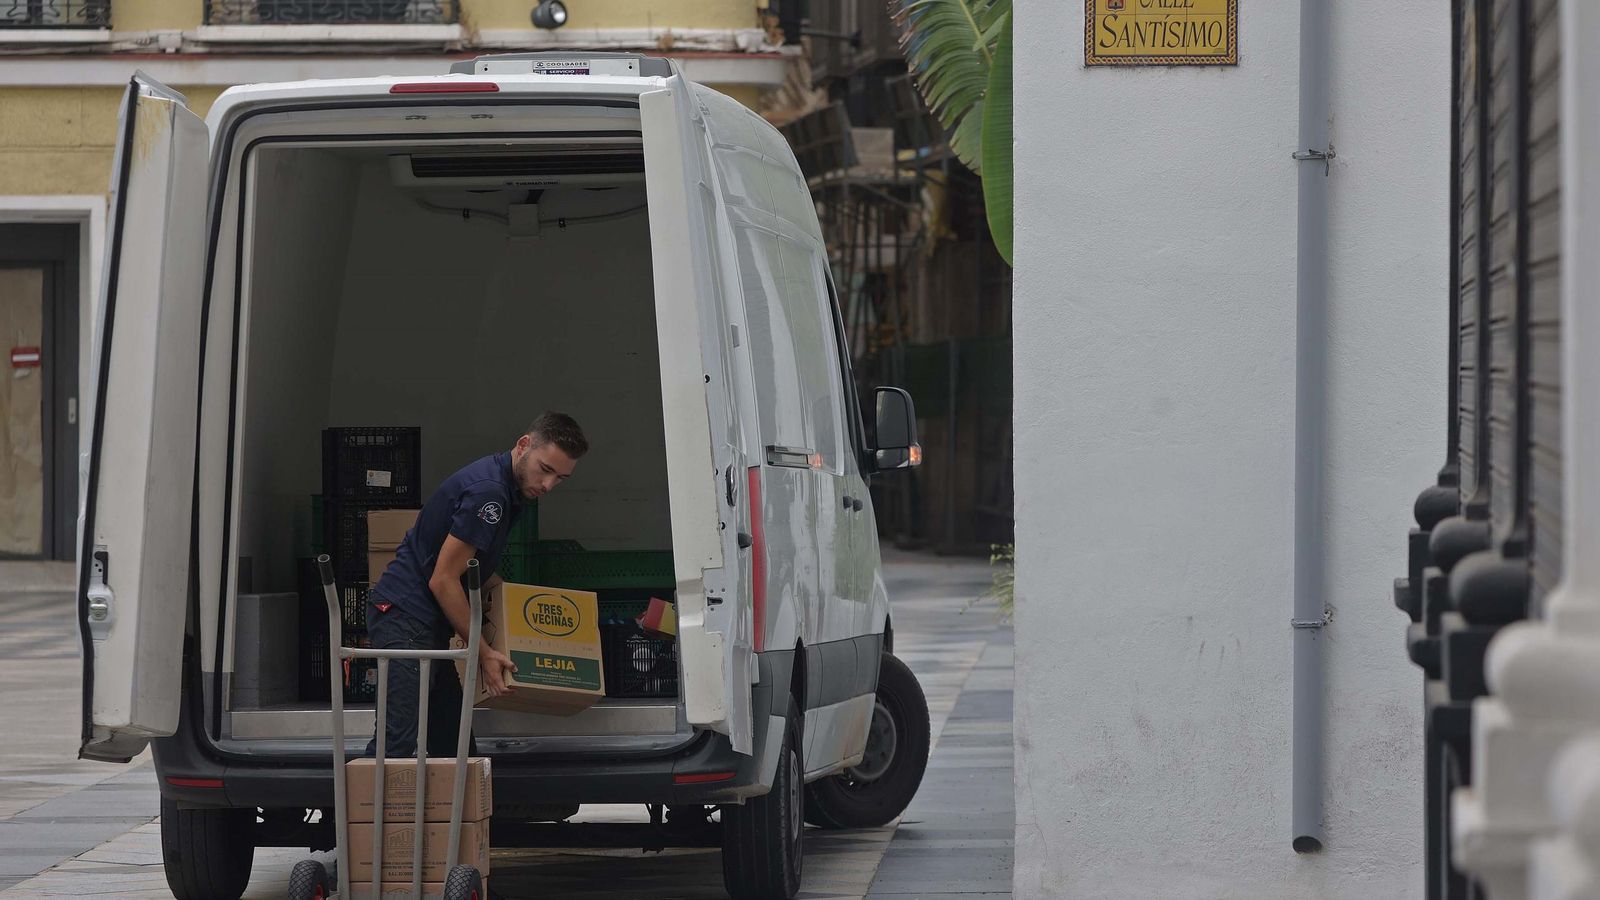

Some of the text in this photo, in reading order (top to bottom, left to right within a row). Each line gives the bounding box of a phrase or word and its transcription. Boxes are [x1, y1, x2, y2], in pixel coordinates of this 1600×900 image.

[537, 603, 562, 615] TRES
[532, 613, 574, 628] VECINAS
[535, 656, 576, 671] LEJIA
